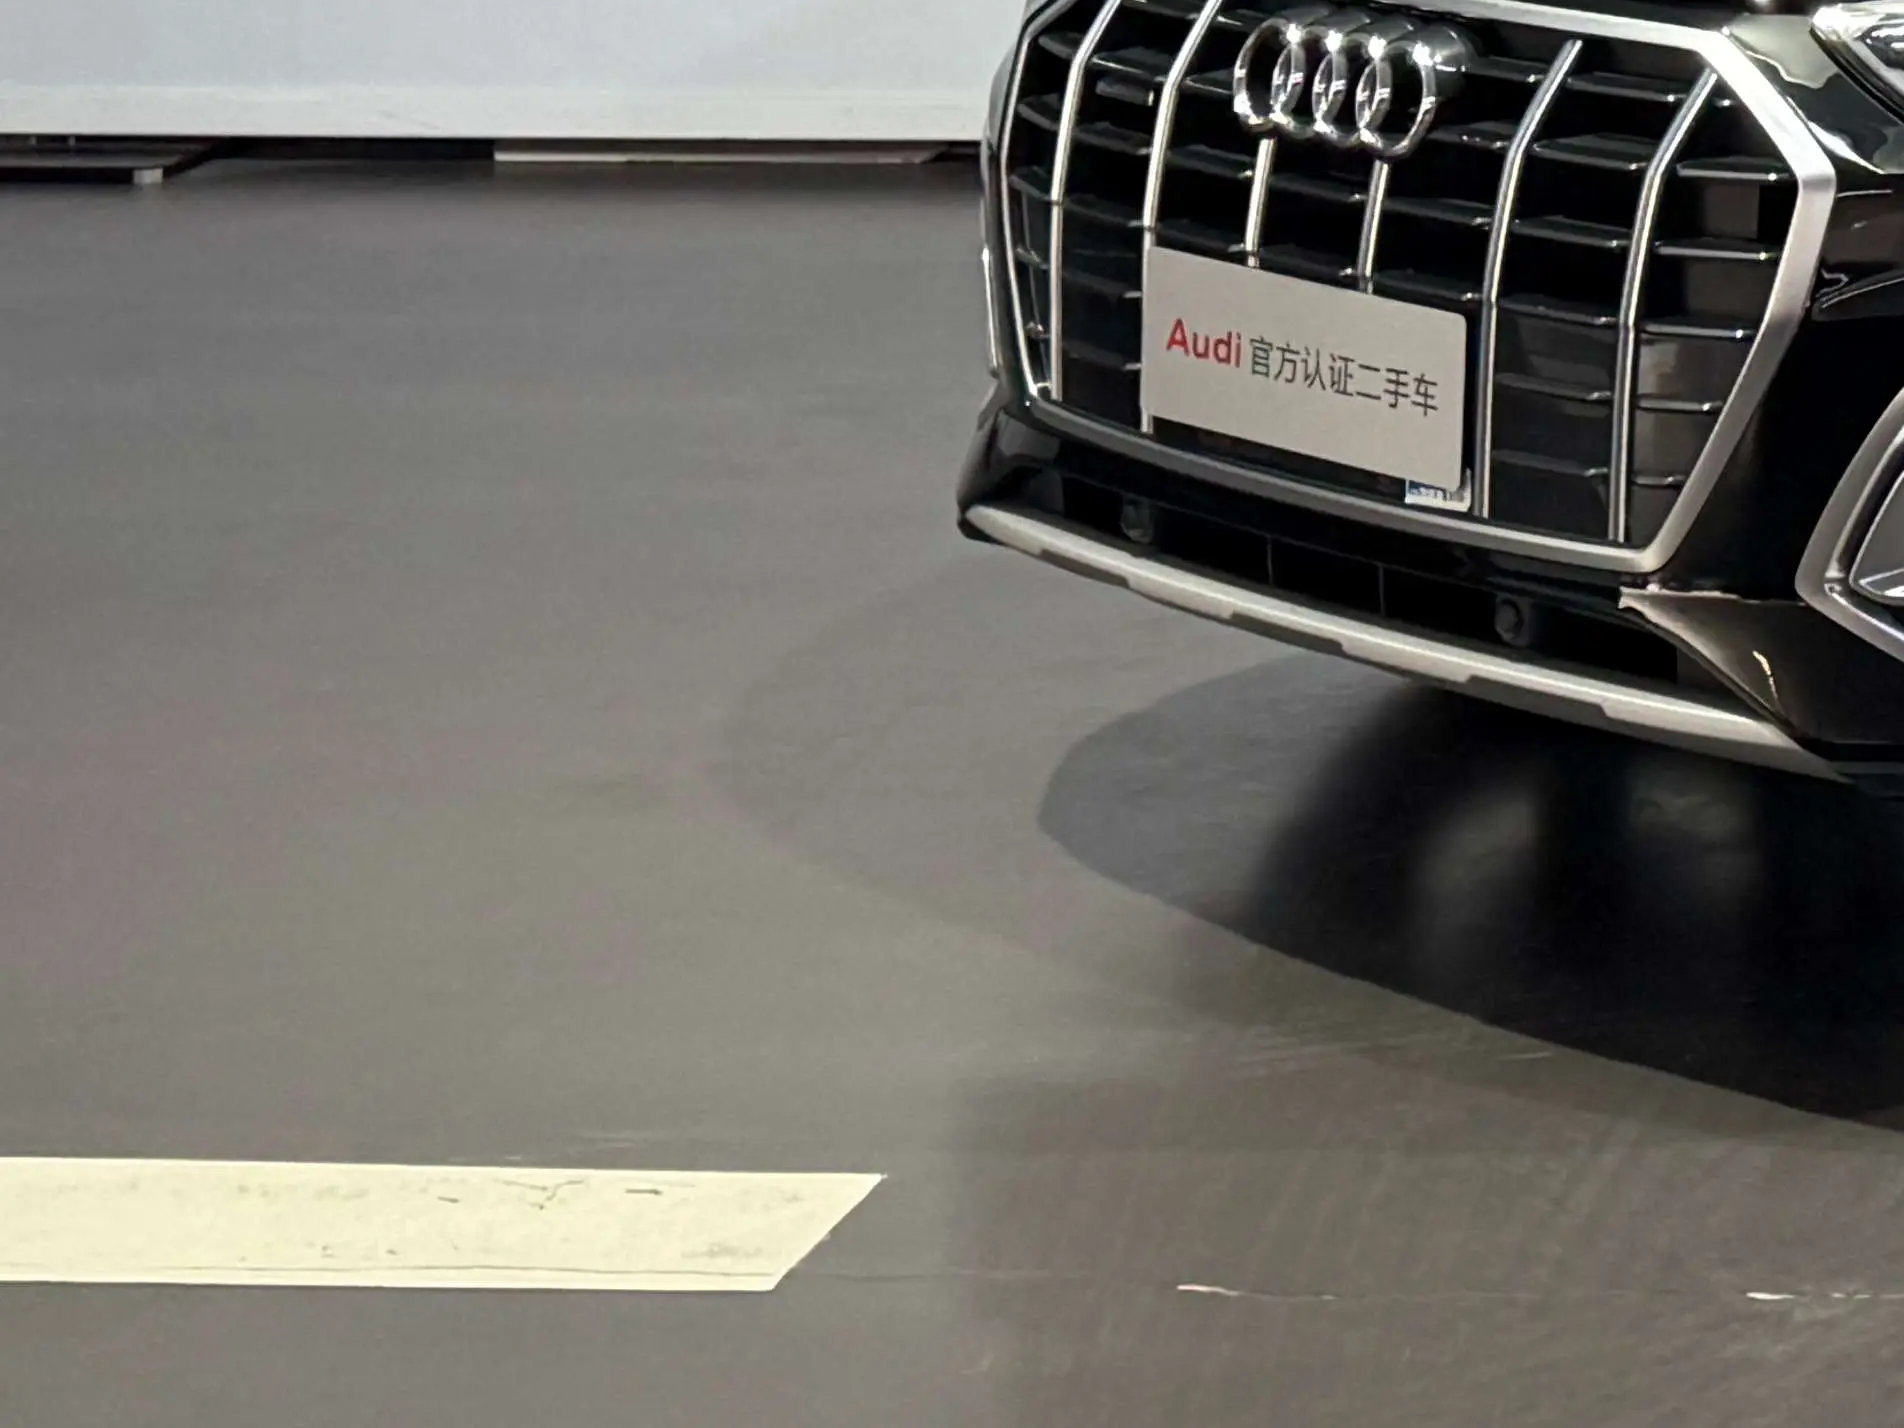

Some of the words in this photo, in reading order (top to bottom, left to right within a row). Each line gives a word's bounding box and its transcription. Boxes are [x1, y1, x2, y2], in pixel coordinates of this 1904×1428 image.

[1165, 317, 1242, 369] Audi
[1249, 335, 1439, 417] 官方认证二手车
